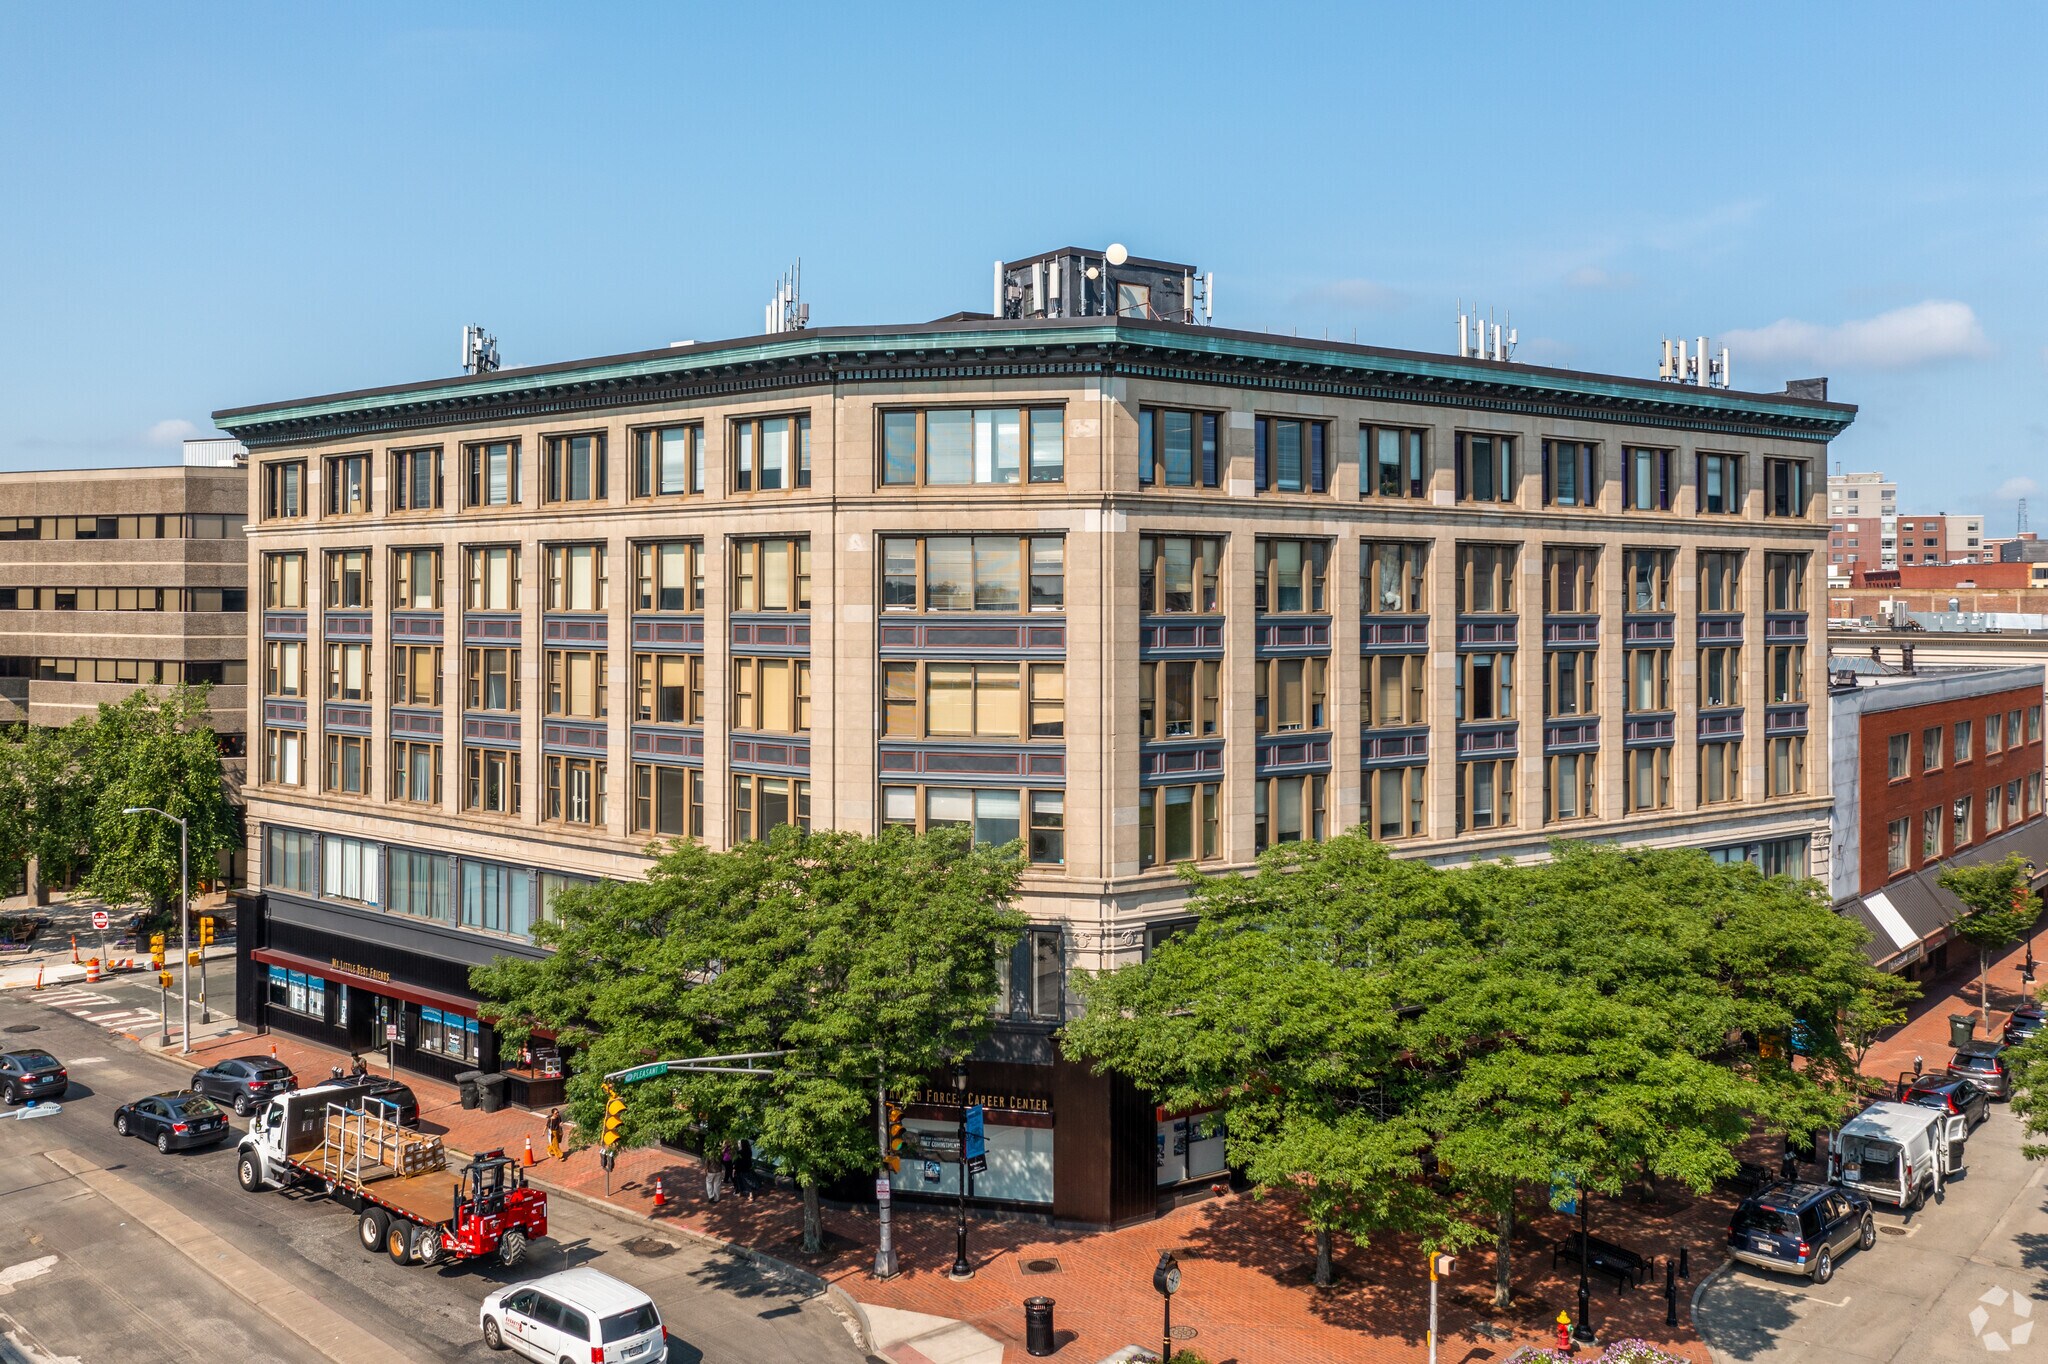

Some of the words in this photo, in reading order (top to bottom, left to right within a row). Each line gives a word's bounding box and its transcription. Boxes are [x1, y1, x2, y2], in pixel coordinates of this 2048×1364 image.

[340, 960, 356, 973] LITTLE
[356, 964, 369, 977] BEST
[370, 967, 390, 982] FRIENDS
[633, 1066, 659, 1080] PLEASANT
[660, 1063, 668, 1073] ST
[968, 1092, 1005, 1108] CAREER
[1009, 1096, 1048, 1111] CENTER
